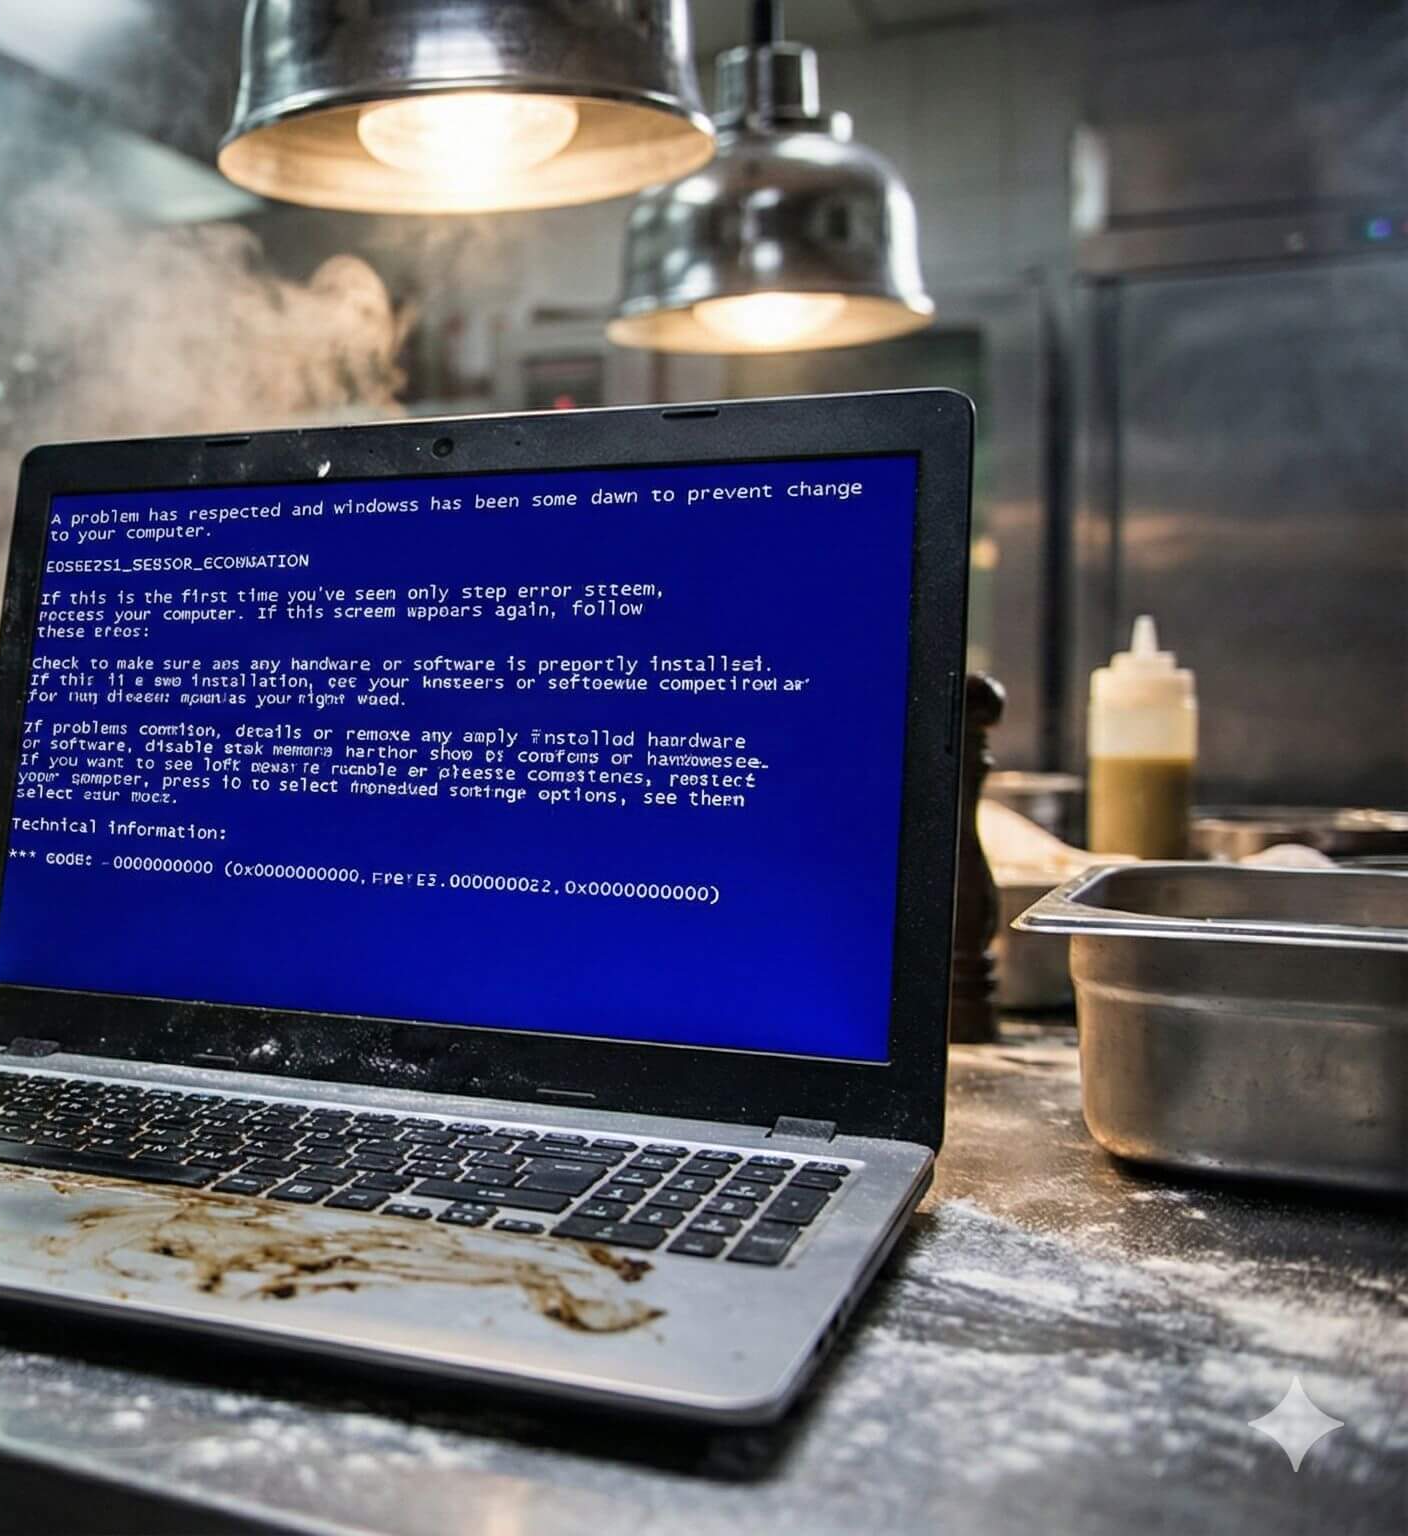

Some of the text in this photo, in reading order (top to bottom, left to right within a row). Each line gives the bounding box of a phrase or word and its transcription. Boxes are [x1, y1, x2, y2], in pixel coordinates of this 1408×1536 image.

[50, 480, 863, 528] A problem has respected and windowss has been some dawn to prevent change
[50, 525, 212, 545] to your computer.
[40, 590, 62, 606] If
[69, 590, 107, 605] this
[117, 589, 135, 605] is
[144, 589, 173, 604] the
[181, 588, 228, 604] first
[236, 587, 279, 603] time
[287, 586, 346, 605] you've
[355, 588, 396, 601] seen
[407, 583, 449, 604] only
[461, 585, 507, 603] step
[517, 585, 573, 599] error
[113, 609, 152, 625] your
[163, 608, 244, 625] computer.
[257, 604, 278, 620] If
[286, 604, 324, 620] this
[494, 600, 556, 621] again,
[571, 599, 644, 617] follow
[37, 624, 85, 639] these
[32, 655, 79, 670] Check
[90, 658, 109, 670] to
[116, 655, 154, 670] make
[163, 659, 202, 671] sure
[250, 659, 281, 675] any
[290, 656, 371, 672] hardware
[382, 659, 403, 672] or
[413, 655, 496, 672] software
[506, 655, 527, 672] is
[30, 672, 50, 686] If
[191, 672, 313, 691] installation,
[367, 677, 410, 693] your
[516, 678, 536, 690] or
[254, 693, 293, 710] your
[52, 719, 128, 737] problems
[313, 728, 334, 740] or
[420, 730, 454, 745] any
[20, 751, 40, 766] If
[48, 755, 79, 770] you
[86, 757, 124, 769] want
[135, 757, 155, 770] to
[164, 759, 193, 771] see
[22, 738, 41, 750] or
[50, 736, 132, 754] software,
[145, 738, 214, 754] disable
[610, 753, 633, 765] or
[16, 783, 73, 800] select
[161, 776, 210, 791] press
[251, 778, 270, 791] to
[279, 776, 339, 793] select
[537, 786, 626, 807] options,
[643, 792, 678, 805] see
[13, 816, 226, 840] Technical information:
